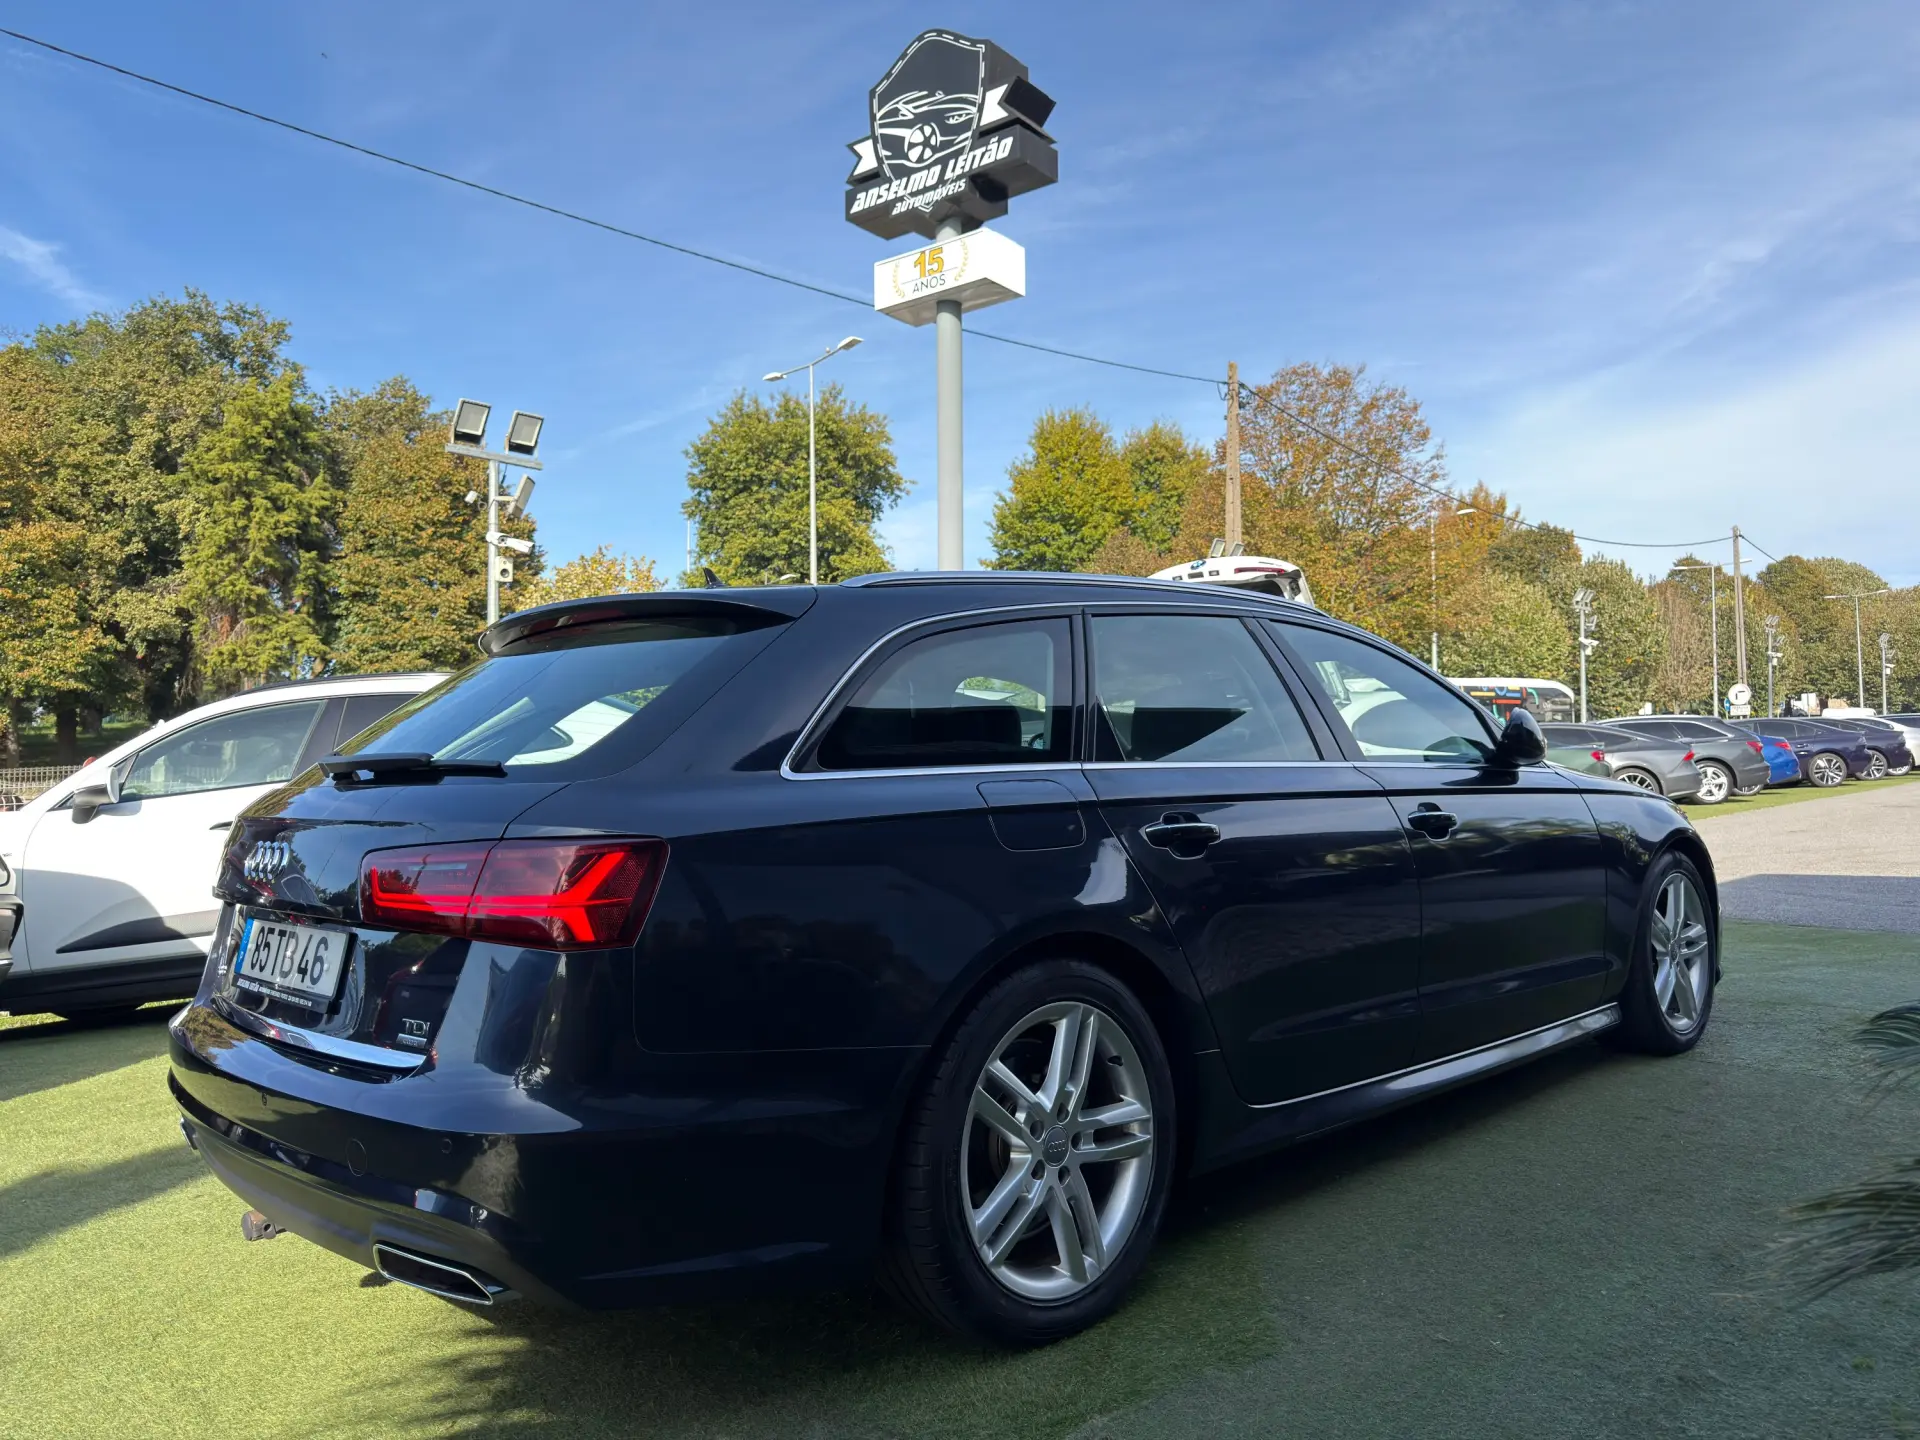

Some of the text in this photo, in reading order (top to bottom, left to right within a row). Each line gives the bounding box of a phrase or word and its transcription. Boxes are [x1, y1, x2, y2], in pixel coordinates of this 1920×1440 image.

[850, 136, 1014, 214] ANSELMO LEITÃO
[891, 178, 966, 215] AUTOMÓVEIS
[913, 246, 945, 279] 15
[912, 273, 946, 294] ANOS
[401, 1017, 431, 1037] TDI
